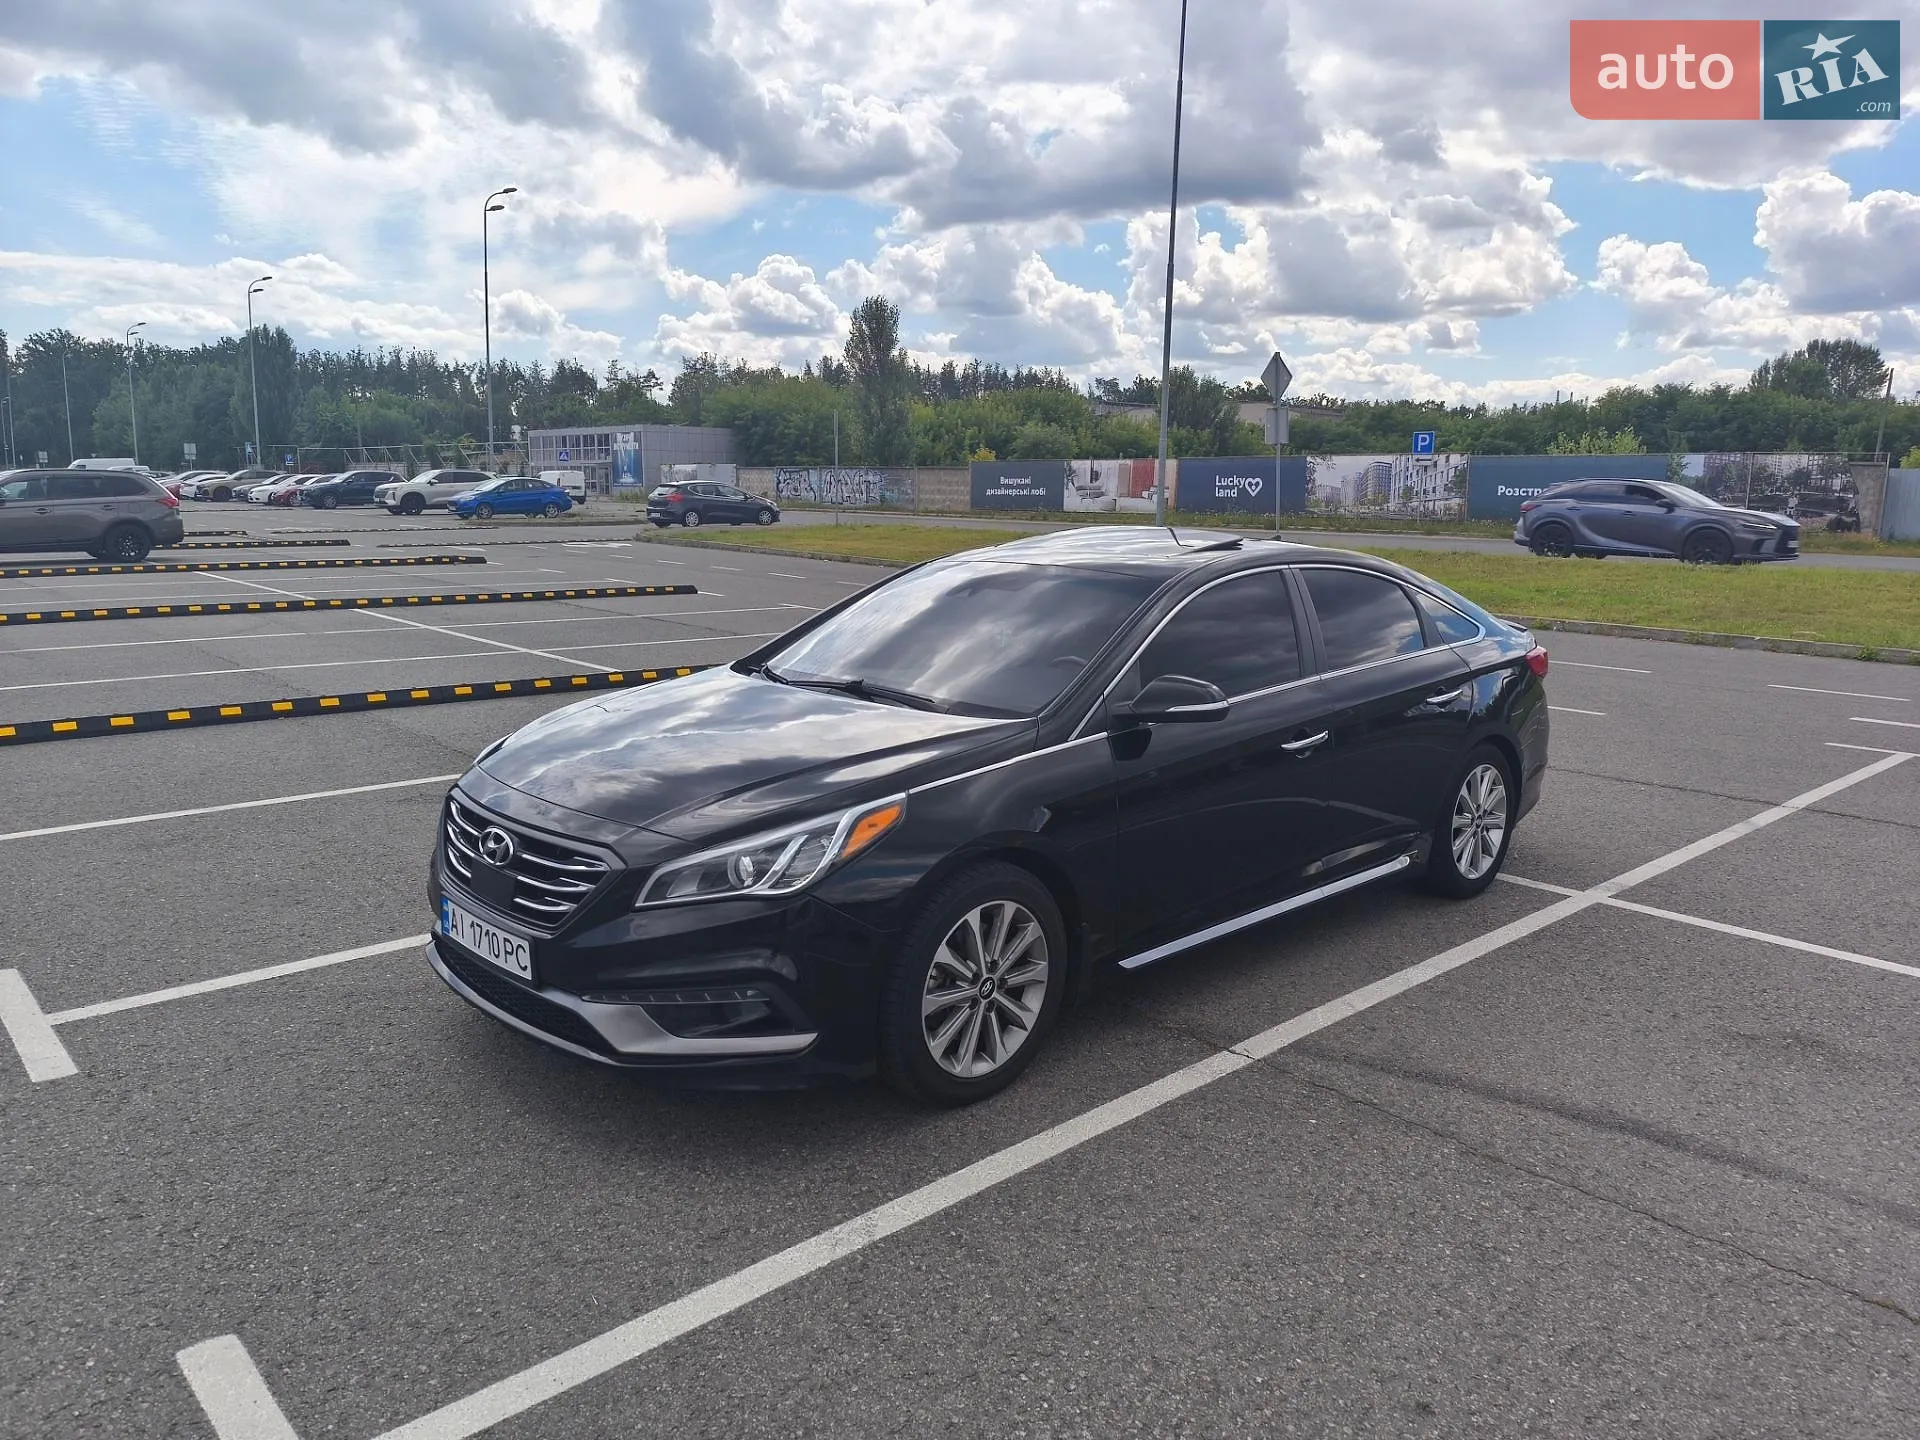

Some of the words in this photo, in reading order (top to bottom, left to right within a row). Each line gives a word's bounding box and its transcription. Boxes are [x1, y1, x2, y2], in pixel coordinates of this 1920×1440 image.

[1417, 434, 1430, 452] P
[1000, 476, 1031, 486] Вишукані
[1216, 475, 1246, 488] Lucky
[1216, 486, 1237, 497] land
[451, 908, 464, 939] AI
[470, 920, 500, 959] 1710
[503, 937, 528, 971] PC
